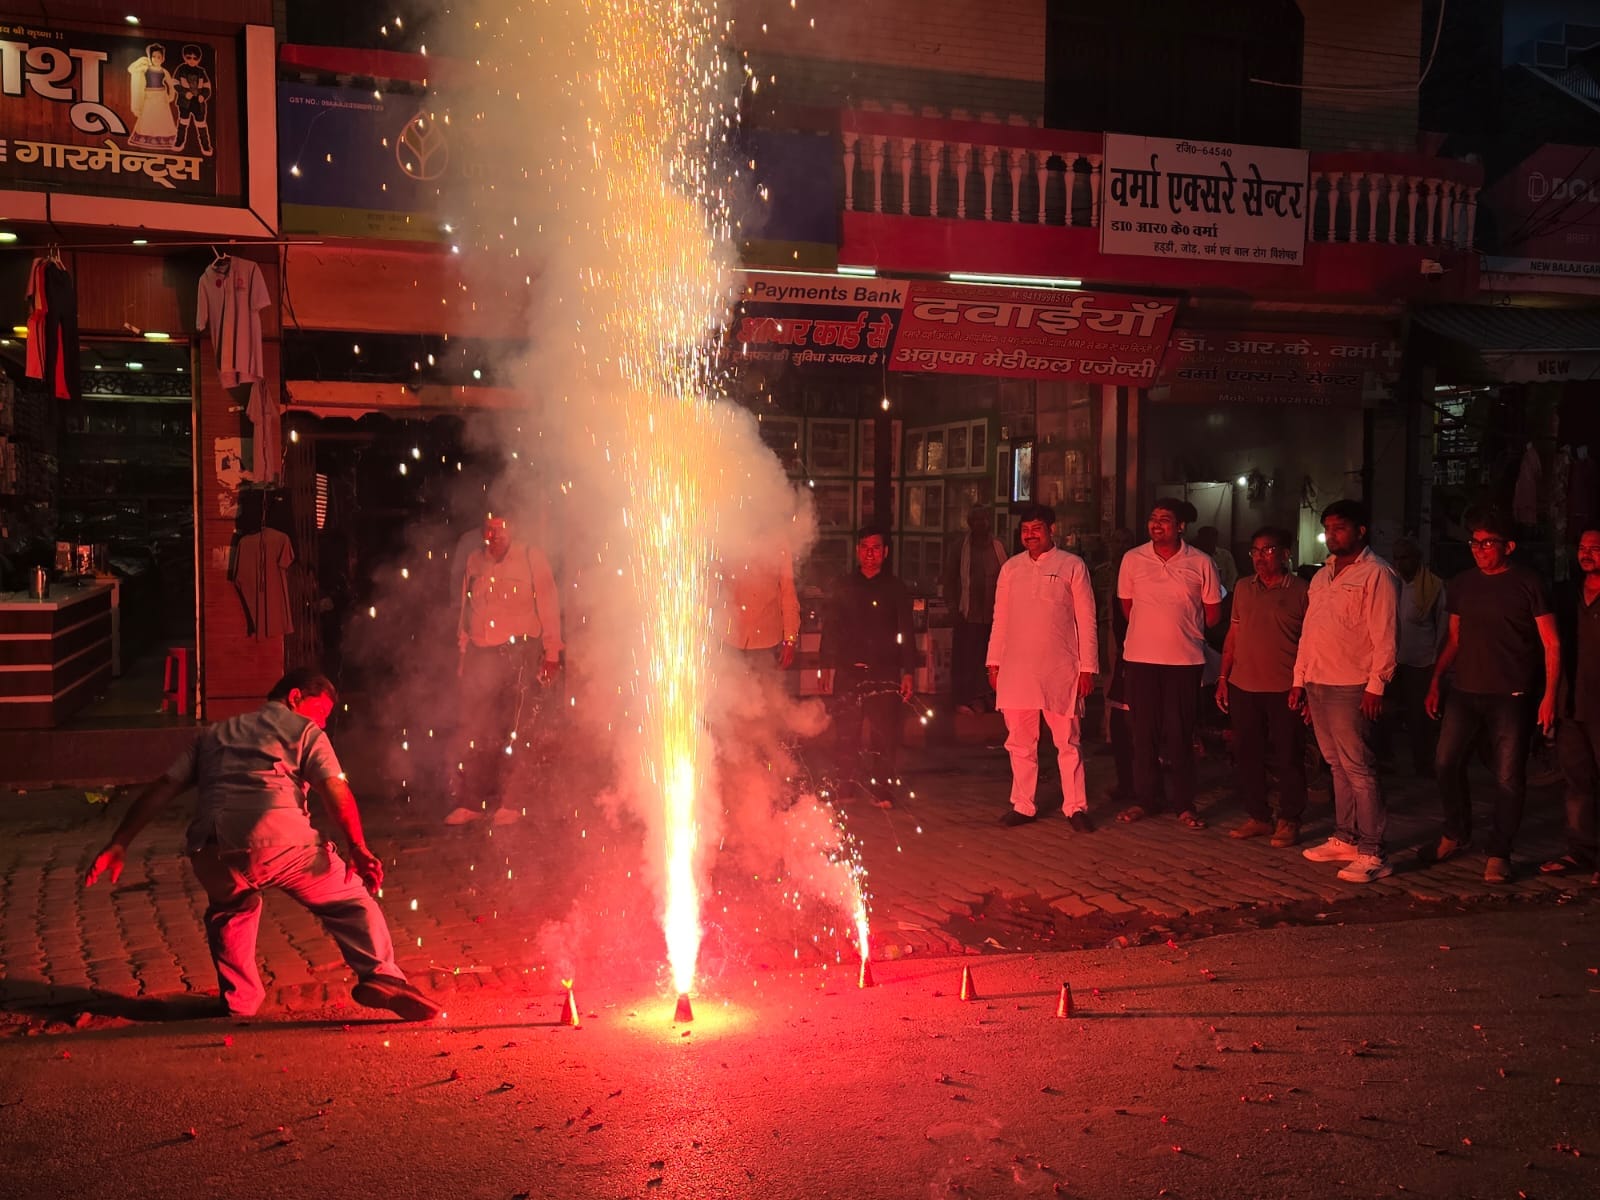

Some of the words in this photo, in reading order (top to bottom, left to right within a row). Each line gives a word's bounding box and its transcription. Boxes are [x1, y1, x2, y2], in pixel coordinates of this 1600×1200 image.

[13, 139, 204, 189] गारमेन्ट्स
[1110, 153, 1161, 208] वर्मा
[1167, 161, 1237, 214] एक्सरे
[1242, 163, 1304, 219] सेन्टर
[1192, 222, 1219, 238] वर्मा
[1530, 261, 1551, 272] NEW
[1552, 262, 1582, 273] BALAJI
[753, 281, 848, 301] Payments
[854, 286, 903, 304] Bank
[911, 296, 1176, 338] दवाईयाँ
[813, 310, 868, 349] कार्ड
[868, 312, 894, 349] से
[792, 349, 825, 367] सुविधा
[827, 352, 866, 364] उपलब्ध
[868, 350, 878, 365] है
[1328, 341, 1377, 359] वर्मा
[896, 347, 978, 370] अनुपम
[981, 349, 1076, 374] मेडीकल
[1078, 355, 1158, 379] एजेन्सी
[1537, 359, 1571, 376] NEW
